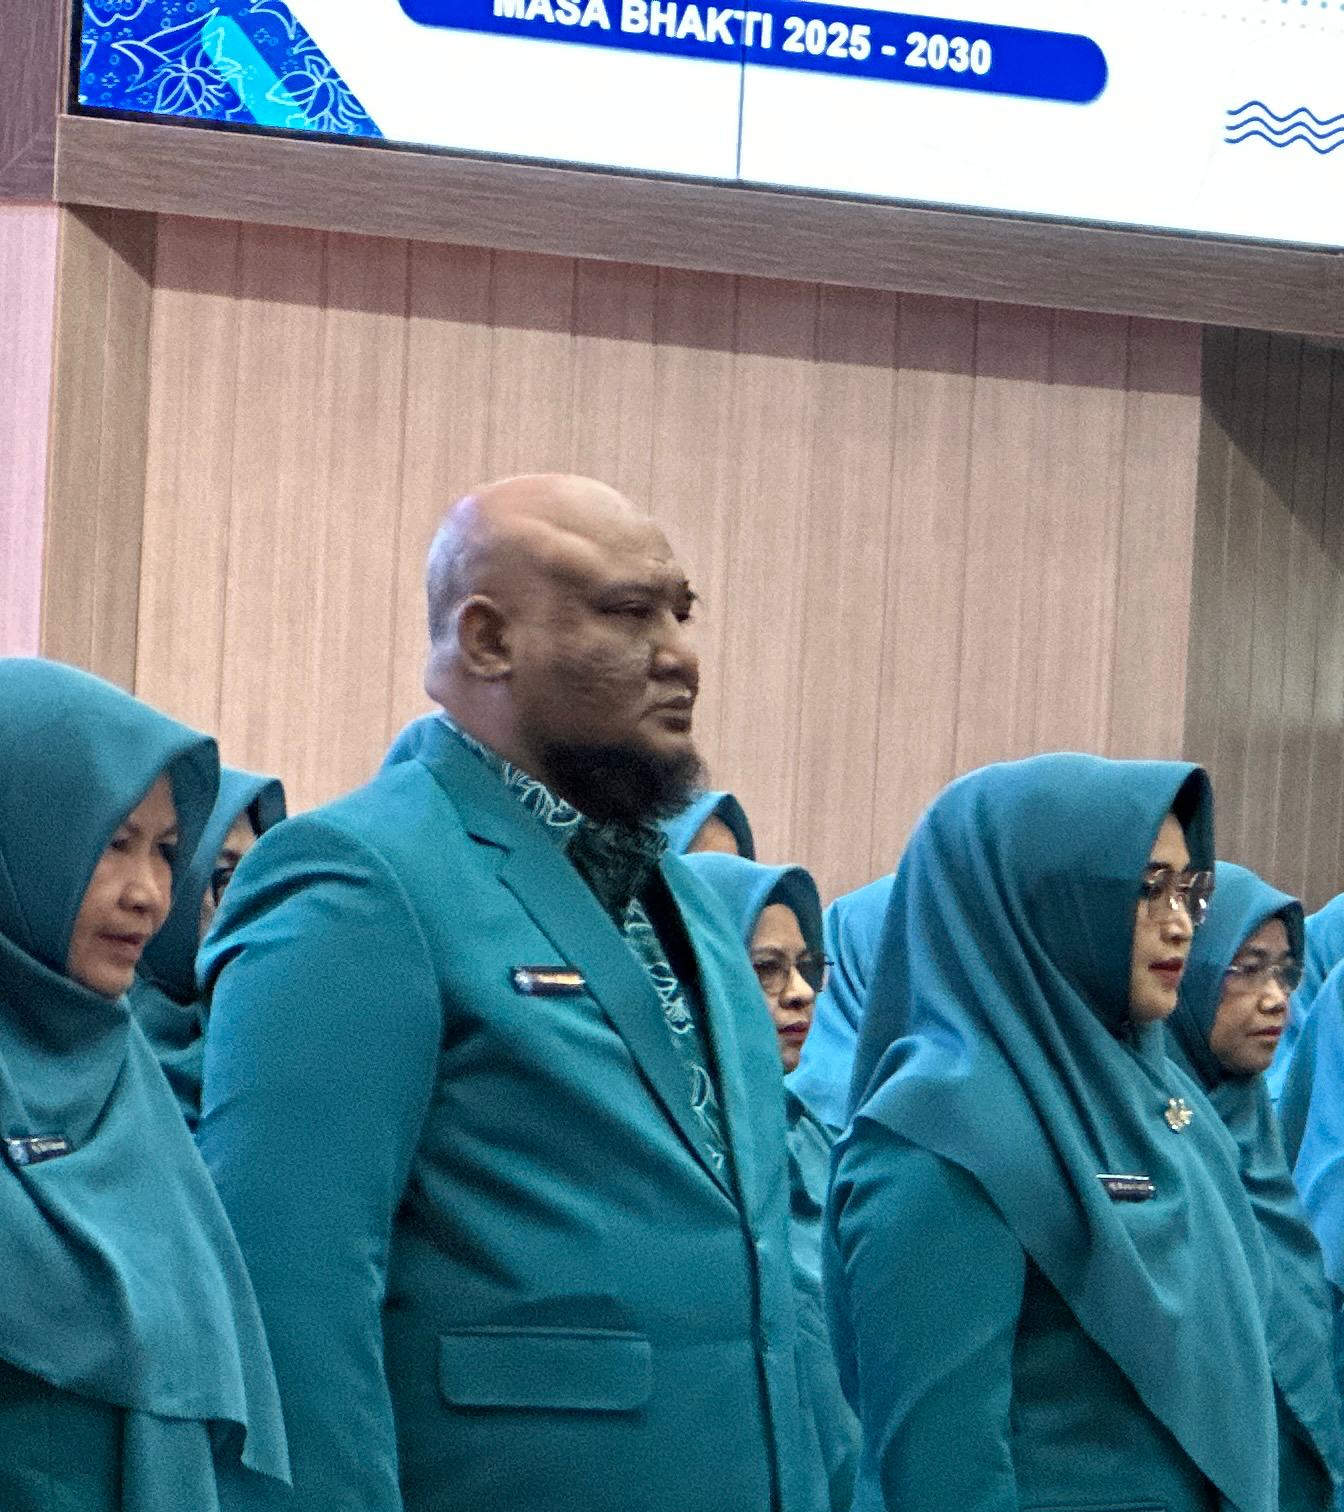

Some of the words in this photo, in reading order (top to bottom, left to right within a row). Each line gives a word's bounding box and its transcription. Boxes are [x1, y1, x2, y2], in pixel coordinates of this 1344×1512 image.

[620, 0, 773, 49] BHAKTI
[782, 16, 872, 61] 2025
[880, 44, 897, 57] -
[904, 31, 993, 76] 2030
